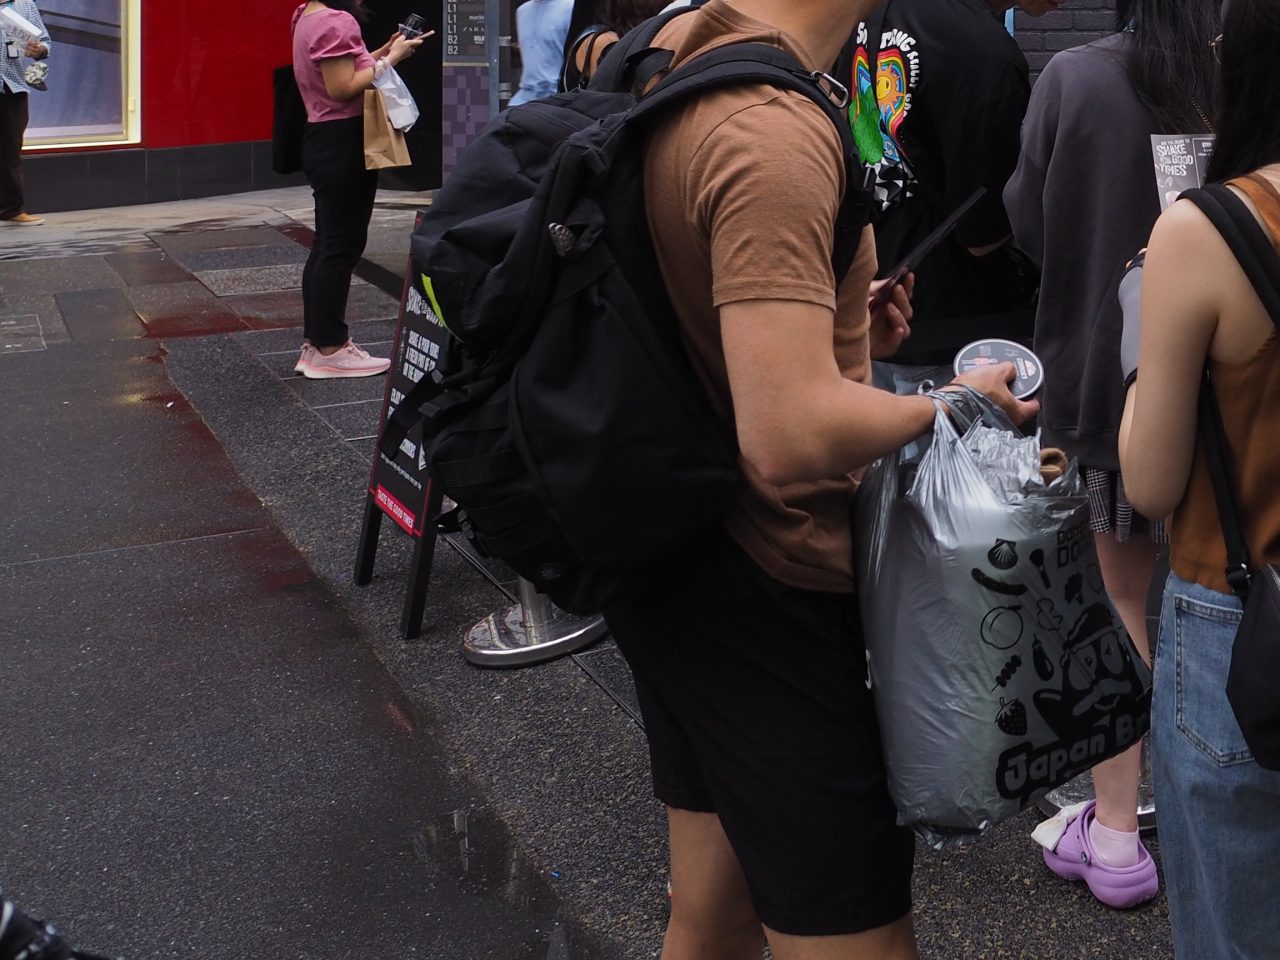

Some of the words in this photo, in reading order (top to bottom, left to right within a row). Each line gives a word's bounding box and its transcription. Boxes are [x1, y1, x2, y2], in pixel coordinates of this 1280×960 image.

[448, 4, 456, 12] L1
[448, 15, 456, 23] L1
[448, 25, 456, 33] L1
[448, 36, 458, 44] B2
[448, 46, 458, 54] B2
[1156, 144, 1187, 157] SHAKE
[1172, 155, 1193, 165] GOOD
[1159, 164, 1187, 176] TIMES
[1004, 733, 1106, 792] Japan
